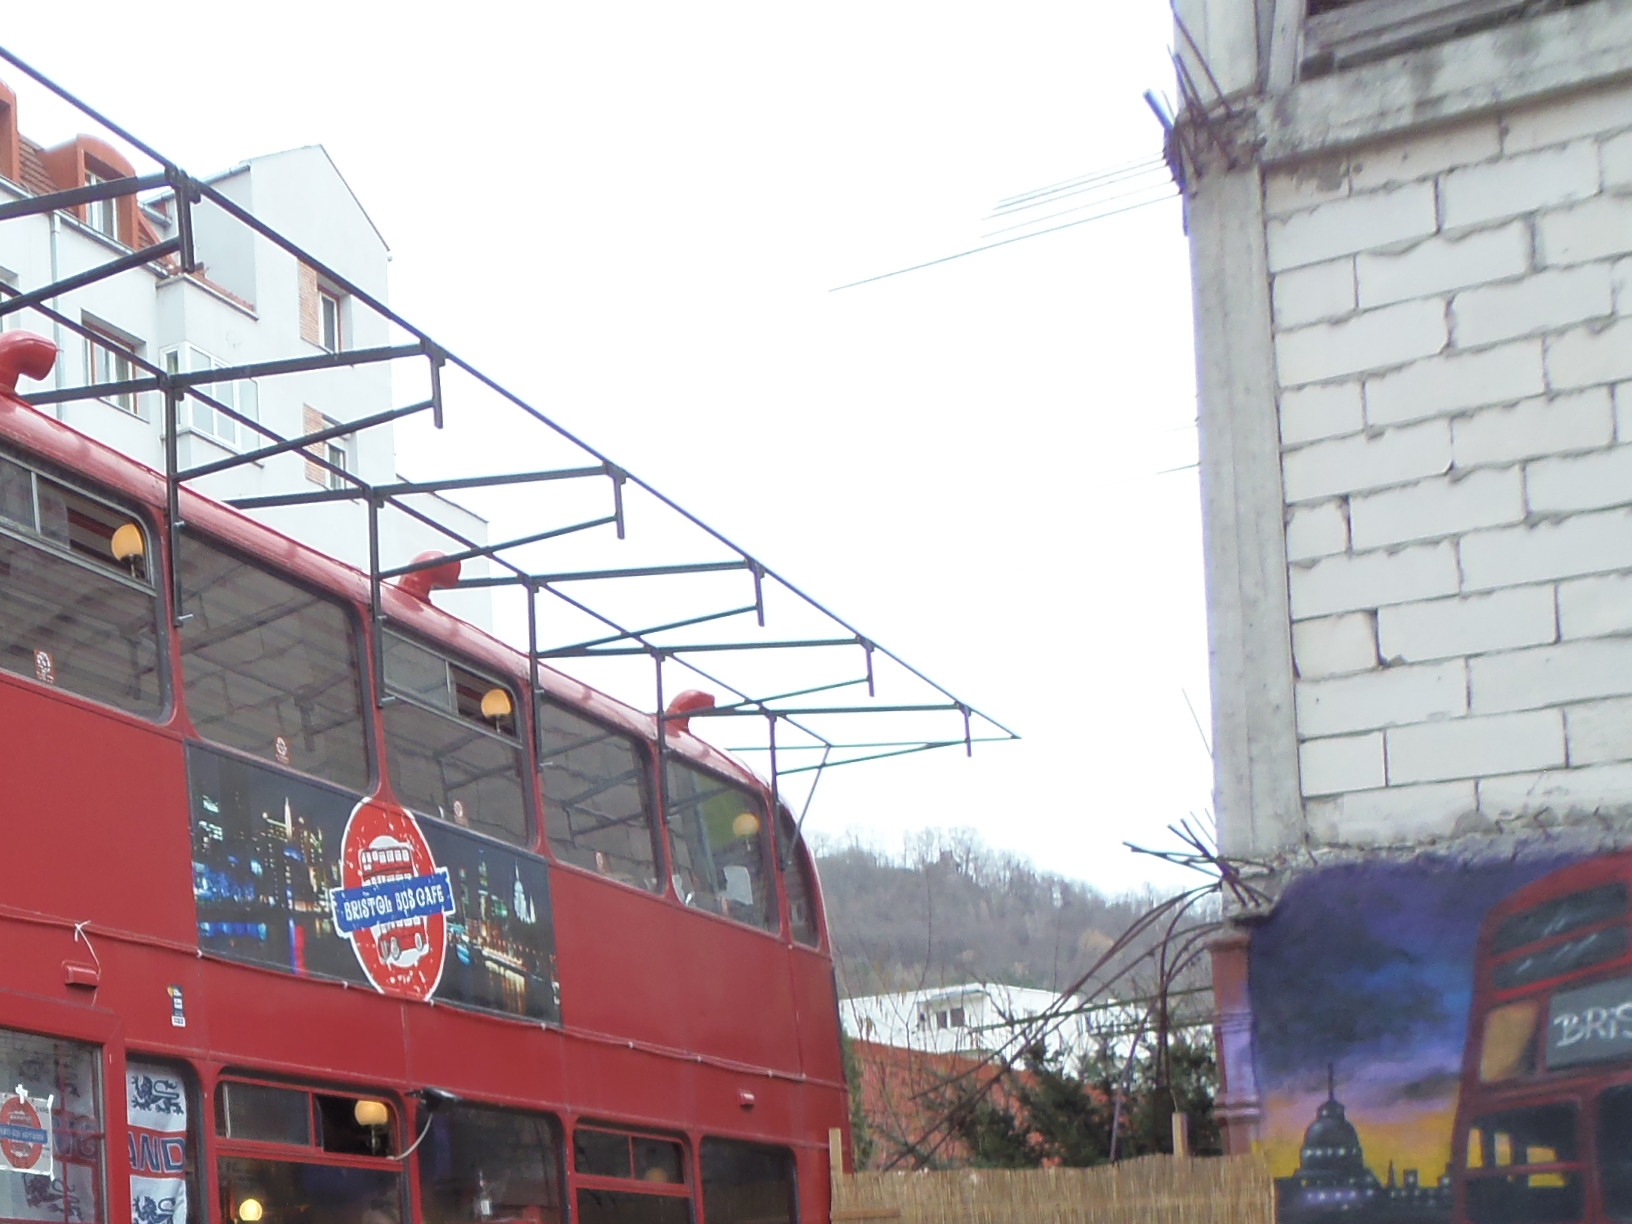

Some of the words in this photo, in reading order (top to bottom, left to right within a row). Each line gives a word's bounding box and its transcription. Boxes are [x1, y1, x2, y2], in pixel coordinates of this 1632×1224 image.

[343, 895, 393, 921] BRISTOL
[395, 888, 416, 911] BUS
[416, 884, 445, 908] CAFE
